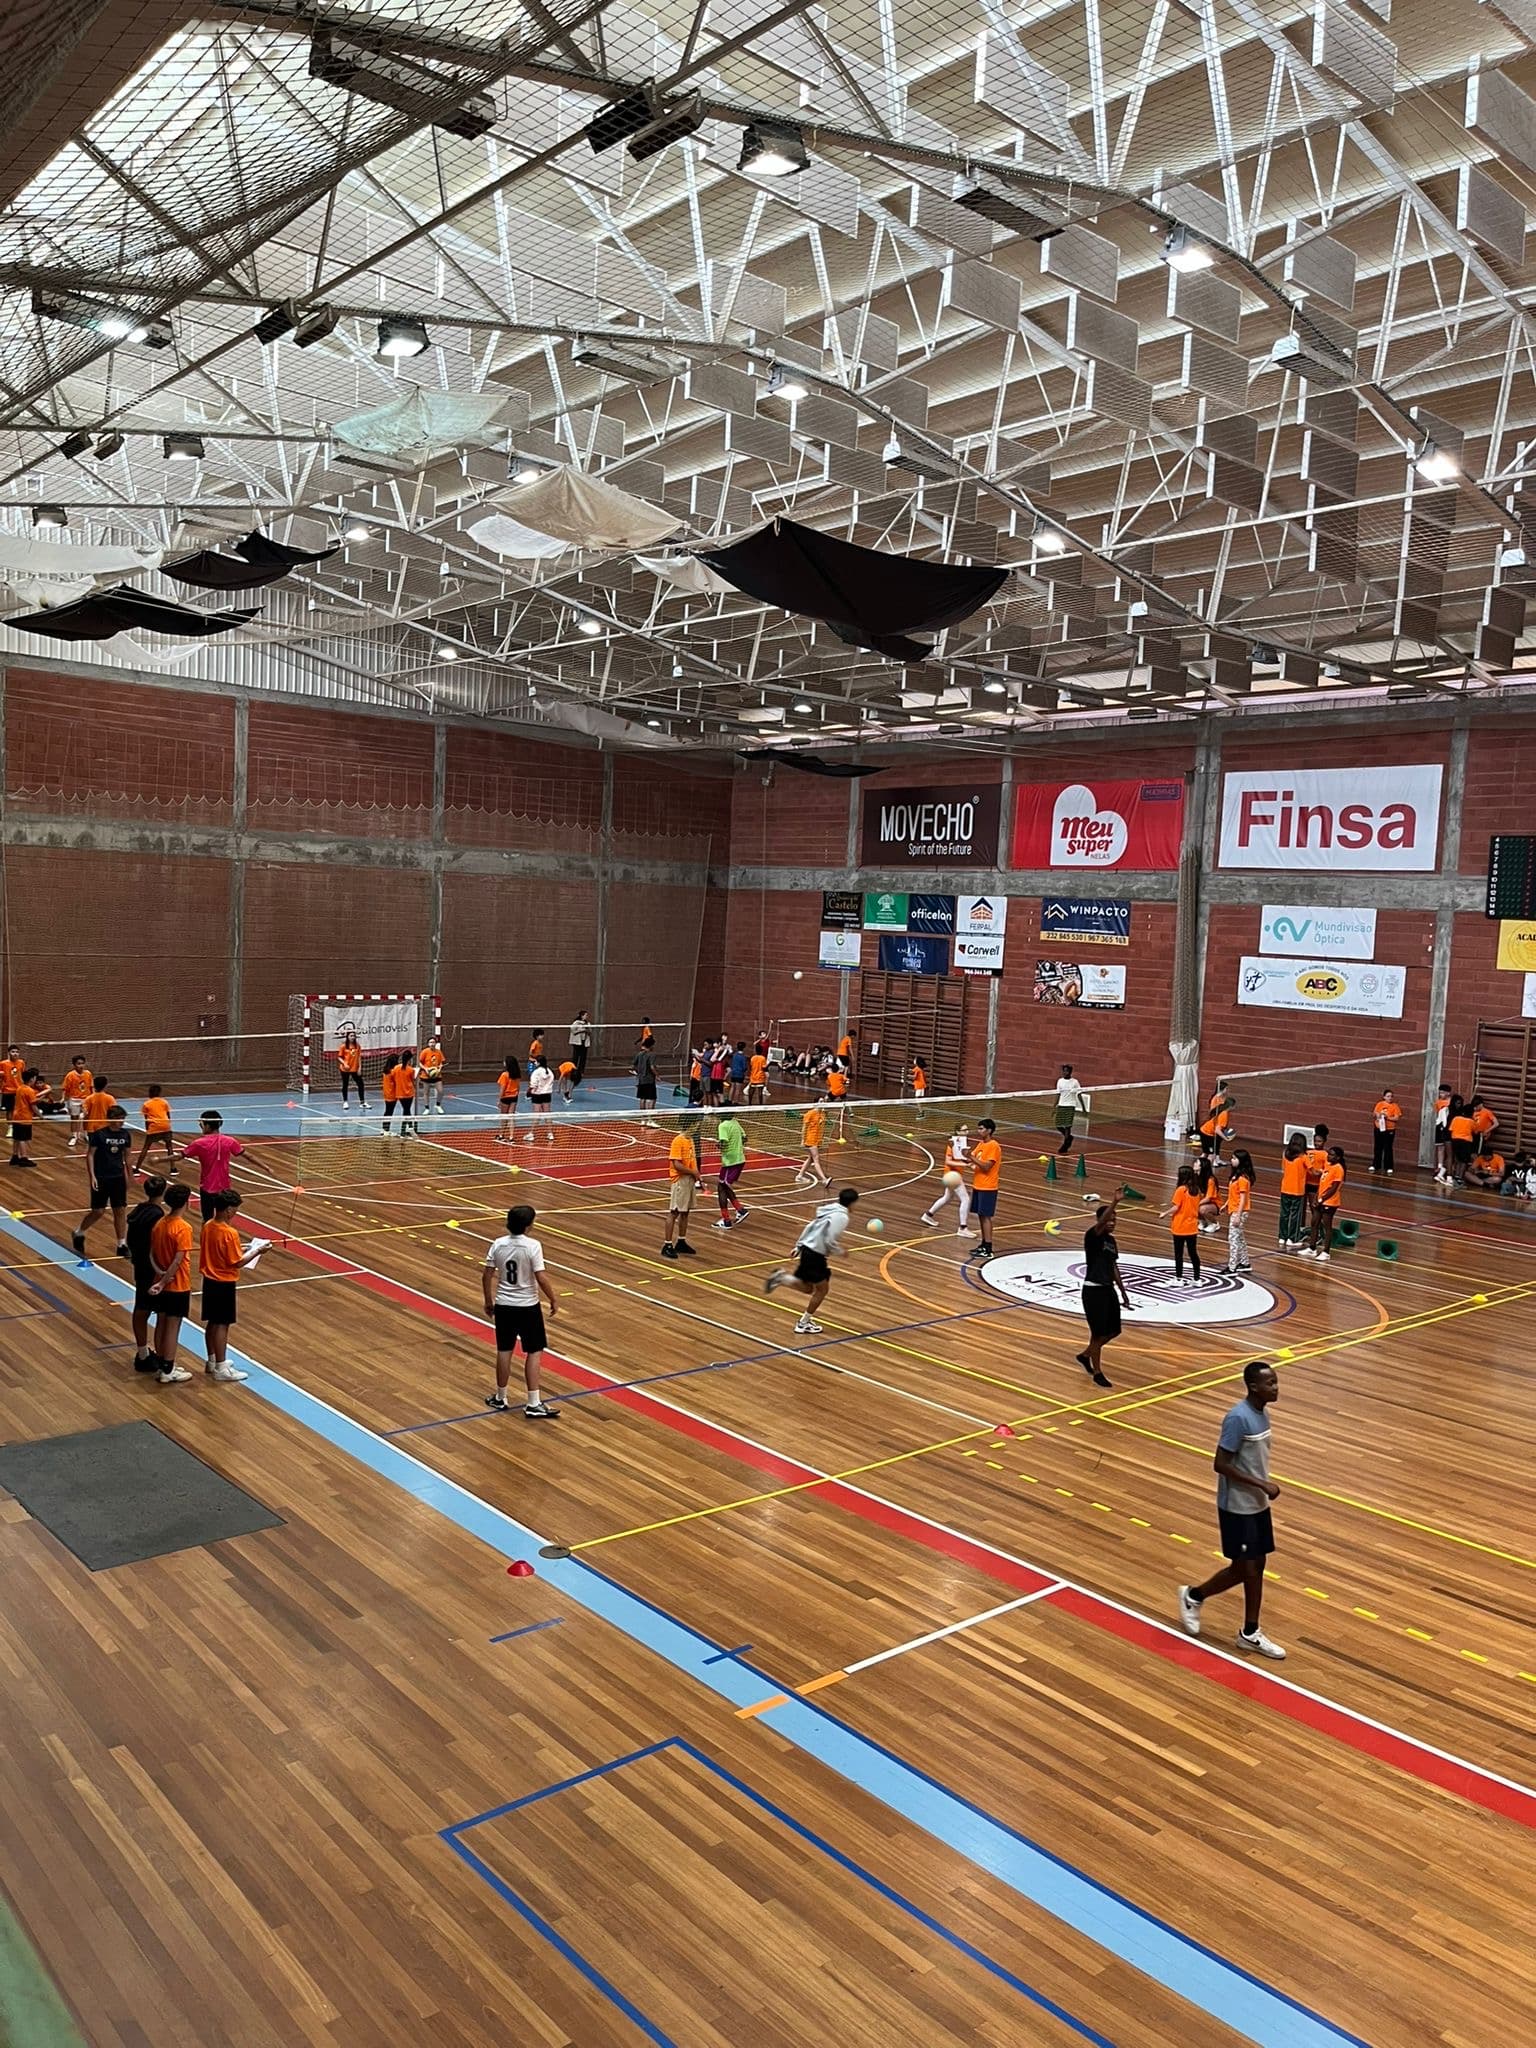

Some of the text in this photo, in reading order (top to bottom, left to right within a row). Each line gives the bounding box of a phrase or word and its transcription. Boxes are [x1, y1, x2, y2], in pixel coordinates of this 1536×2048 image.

[880, 802, 974, 842] MOVECHO
[1237, 790, 1417, 849] Finsa
[908, 843, 972, 857] Spirit of the Future
[1066, 839, 1113, 856] super
[1090, 852, 1110, 860] NELAS
[911, 908, 952, 920] officelan
[1070, 905, 1128, 917] WINPACTO
[1314, 921, 1372, 933] Mundivisão
[1314, 933, 1346, 945] Óptica
[1304, 977, 1338, 991] ABC
[506, 1259, 518, 1285] 8
